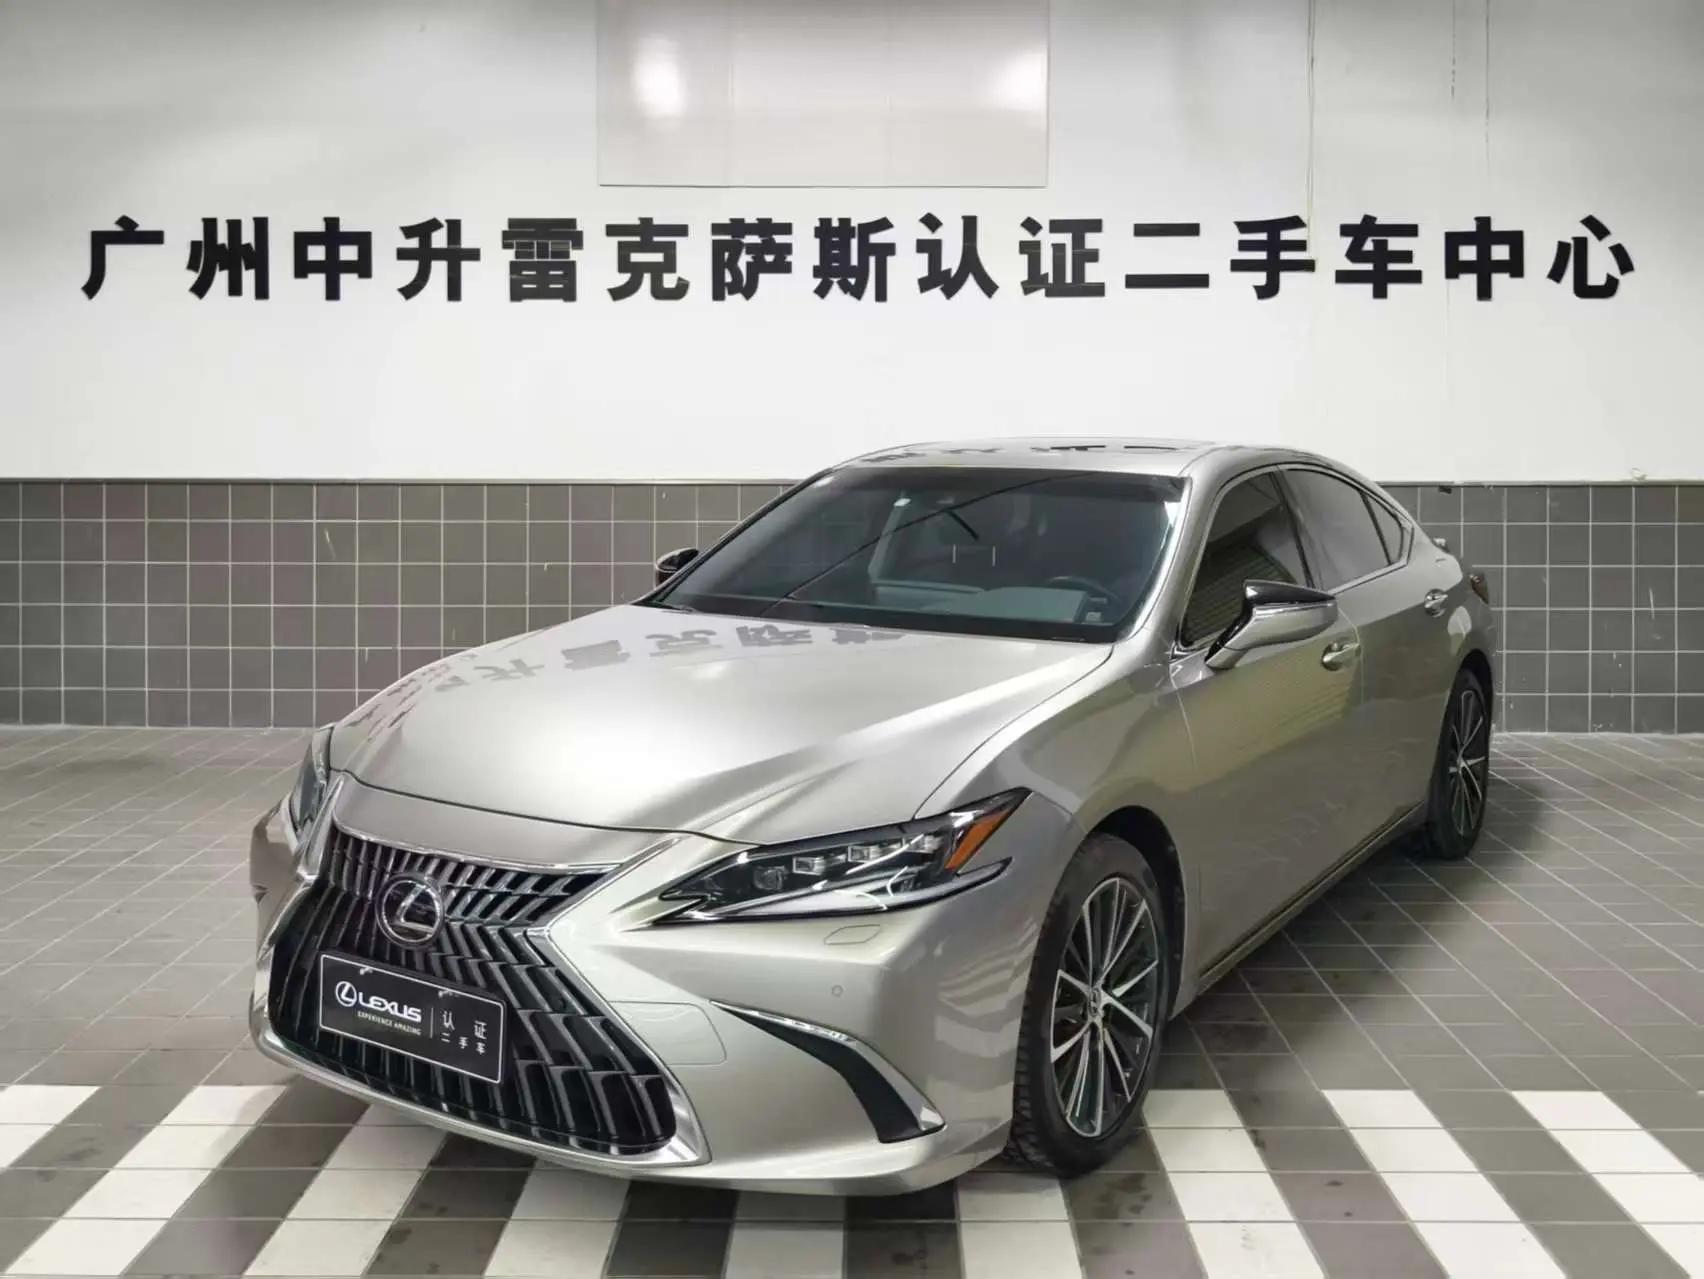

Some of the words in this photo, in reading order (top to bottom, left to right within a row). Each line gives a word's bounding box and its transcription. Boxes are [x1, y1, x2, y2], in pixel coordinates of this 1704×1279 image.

[82, 213, 1636, 303] 广州中升雷克萨斯认证二手车中心
[358, 991, 422, 1022] LEXUS
[357, 1011, 393, 1027] EXPERIENCE
[394, 1022, 422, 1036] AMAZING
